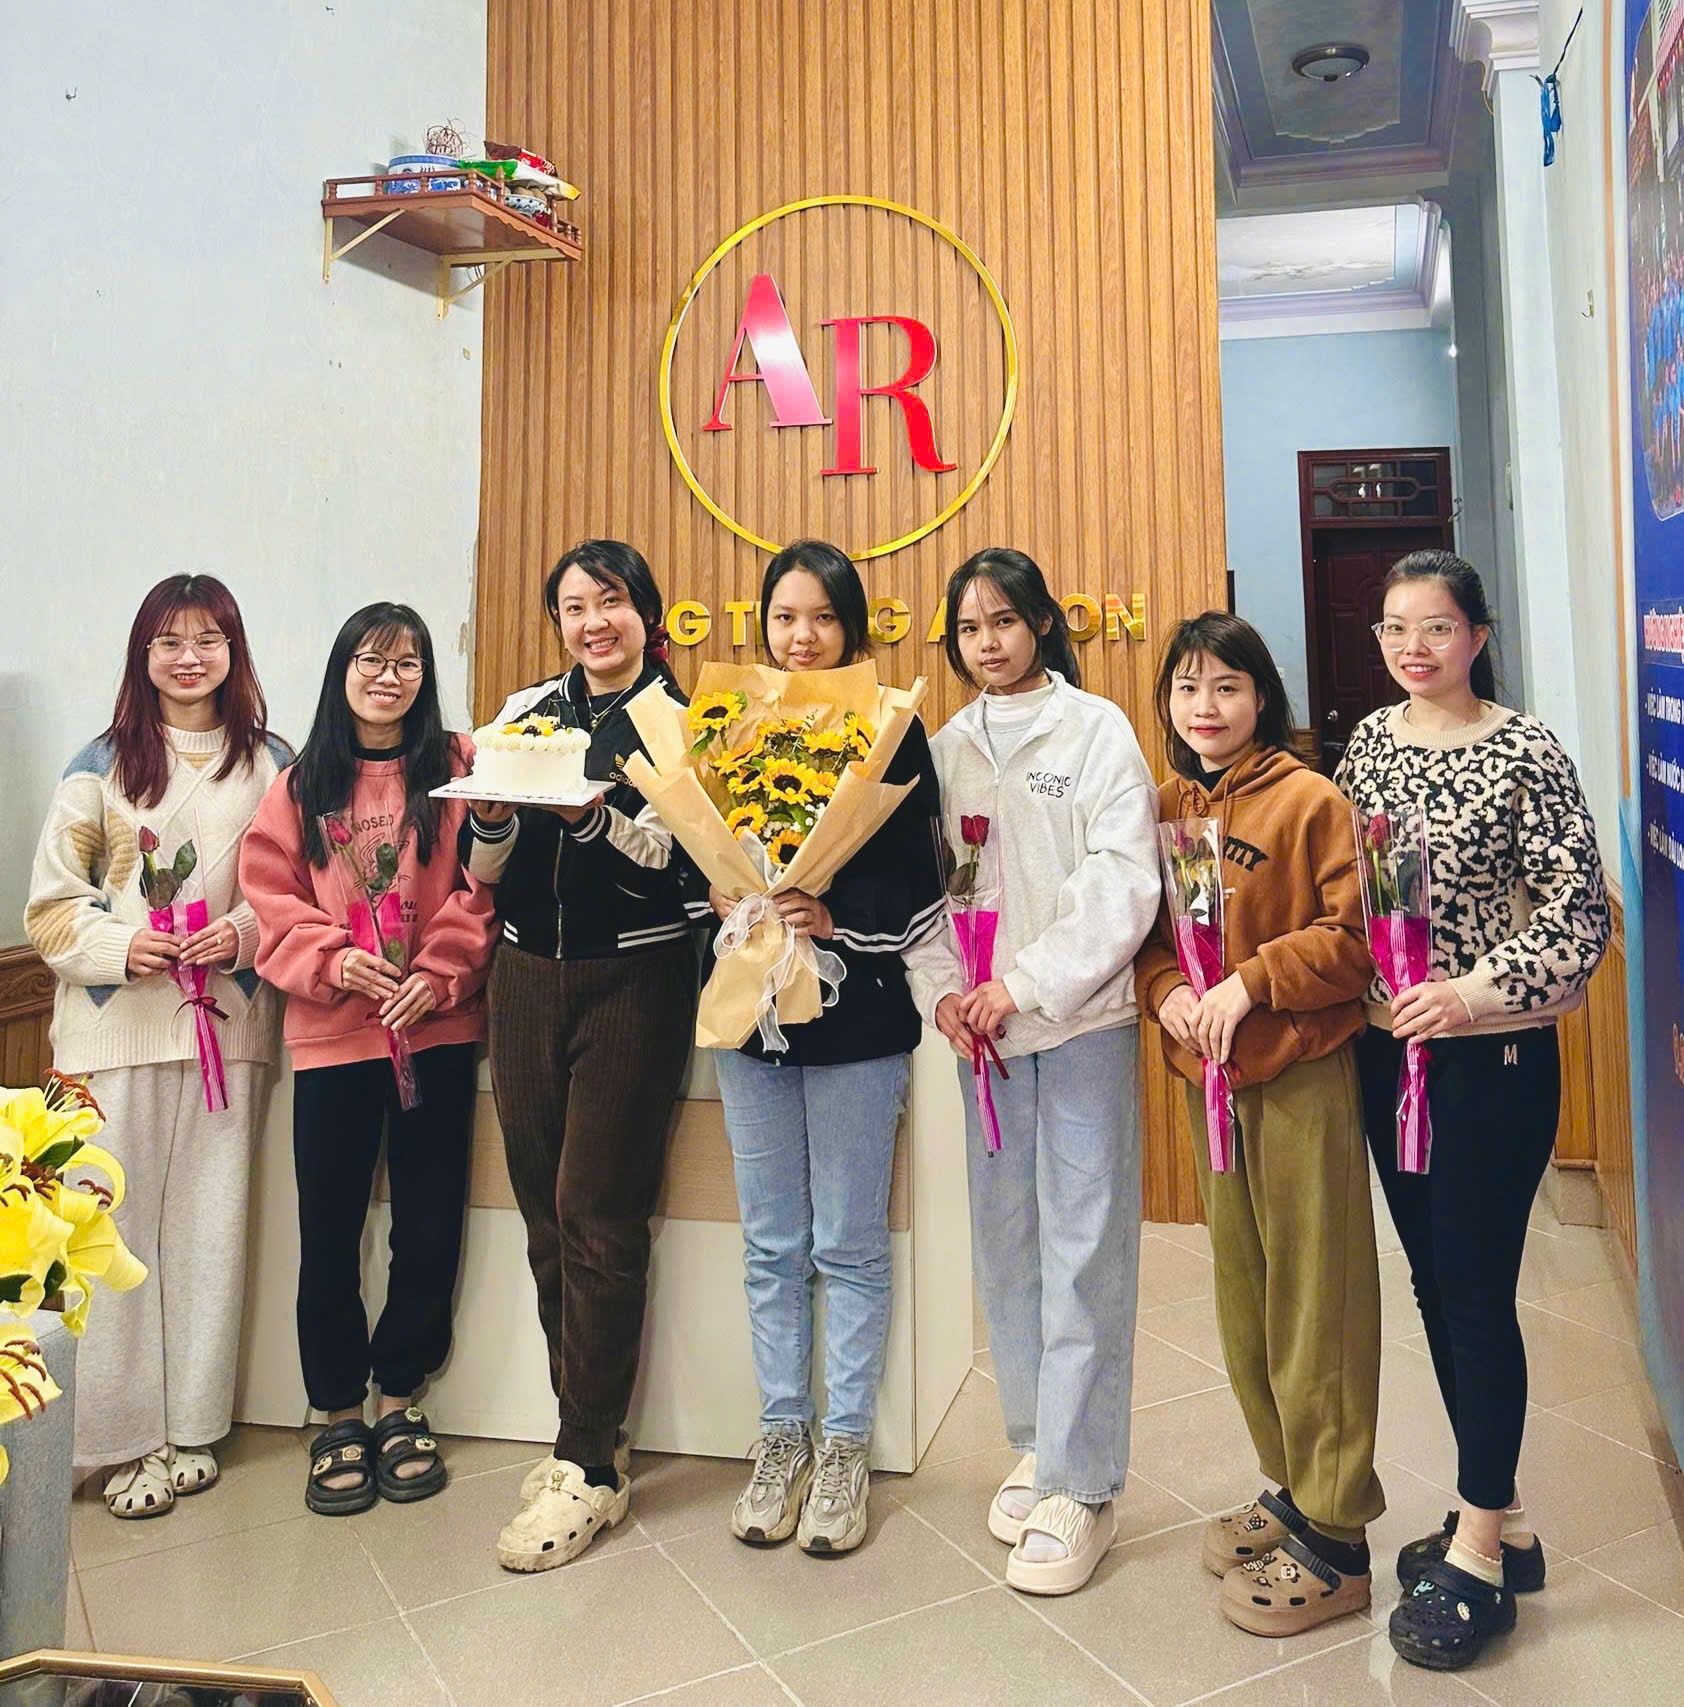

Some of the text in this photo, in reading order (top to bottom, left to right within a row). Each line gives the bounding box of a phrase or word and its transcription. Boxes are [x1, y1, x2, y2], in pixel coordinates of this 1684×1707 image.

[702, 273, 957, 476] AR
[1026, 771, 1071, 787] INCONIC
[1030, 782, 1064, 798] VIBES
[1504, 1043, 1518, 1066] M
